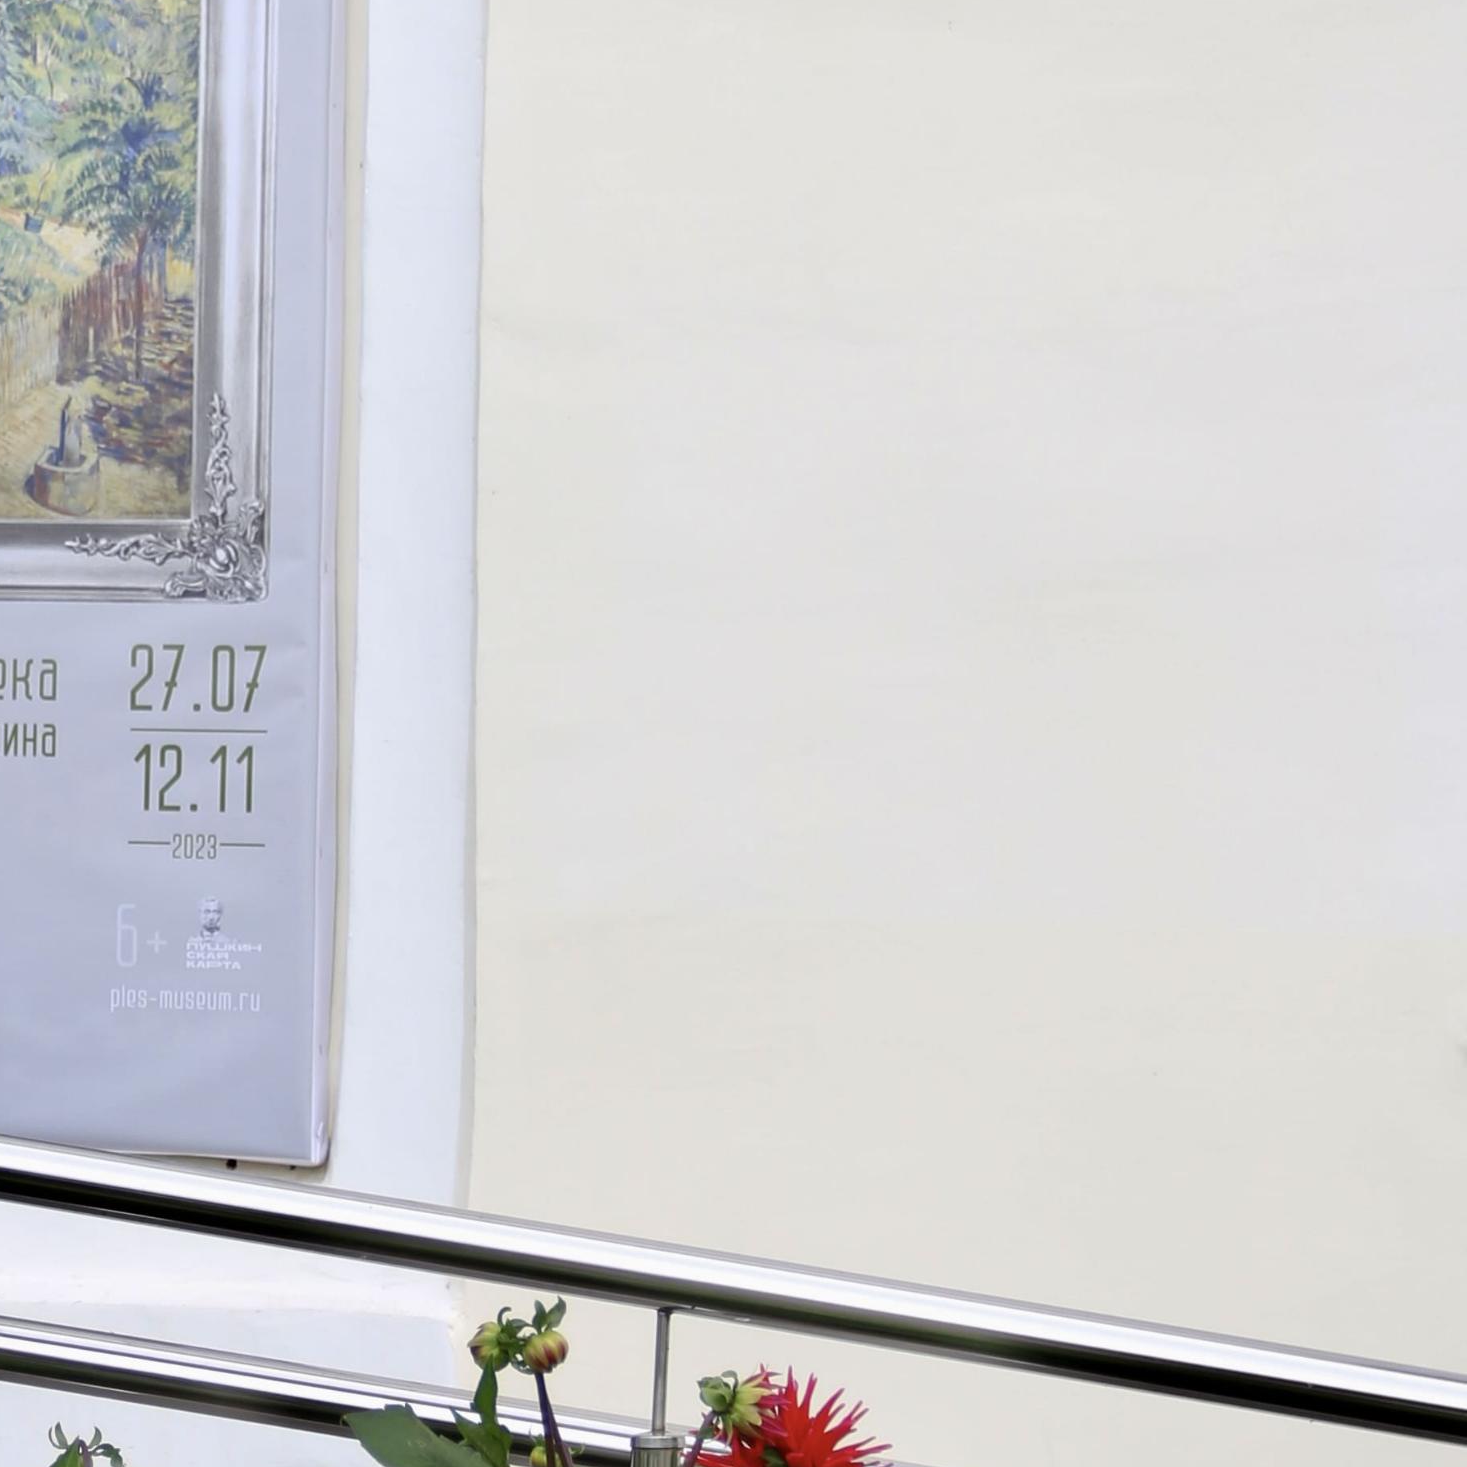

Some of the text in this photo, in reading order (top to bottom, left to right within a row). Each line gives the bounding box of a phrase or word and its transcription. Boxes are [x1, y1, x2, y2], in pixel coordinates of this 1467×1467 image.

[130, 644, 267, 713] 27.07
[134, 744, 254, 813] 12.11
[172, 834, 218, 860] 2023
[116, 903, 168, 968] 6+
[110, 985, 261, 1012] ples-museum.ru
